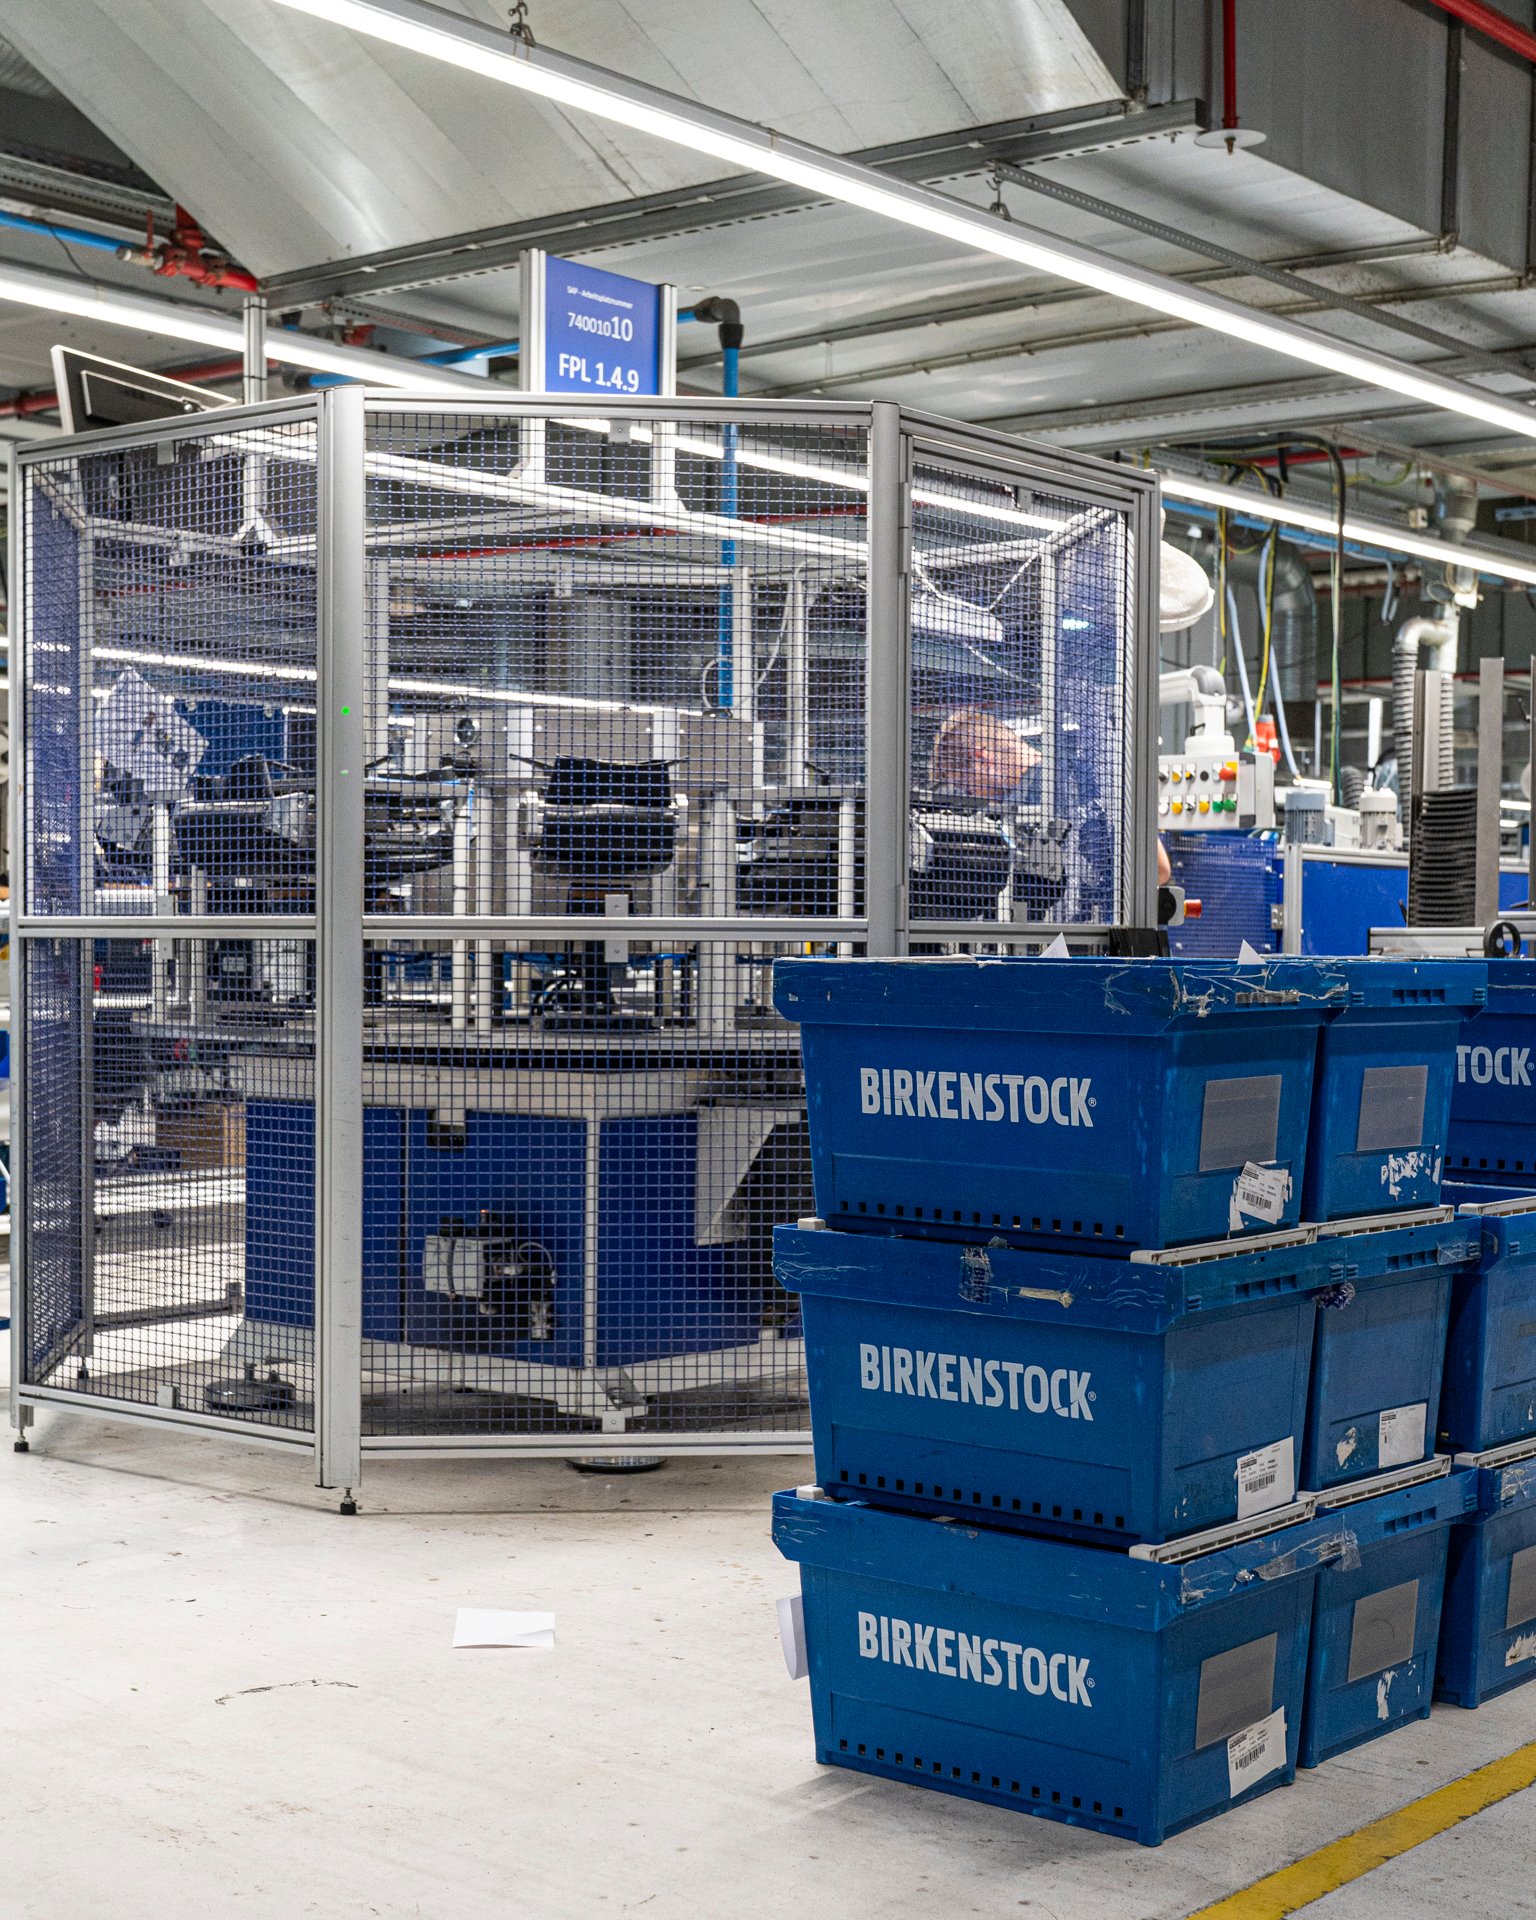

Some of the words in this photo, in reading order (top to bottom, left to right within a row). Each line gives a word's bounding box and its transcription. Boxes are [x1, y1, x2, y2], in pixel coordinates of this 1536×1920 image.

[567, 312, 633, 342] 74001010
[559, 353, 591, 383] FPL
[595, 362, 639, 393] 1.4.9
